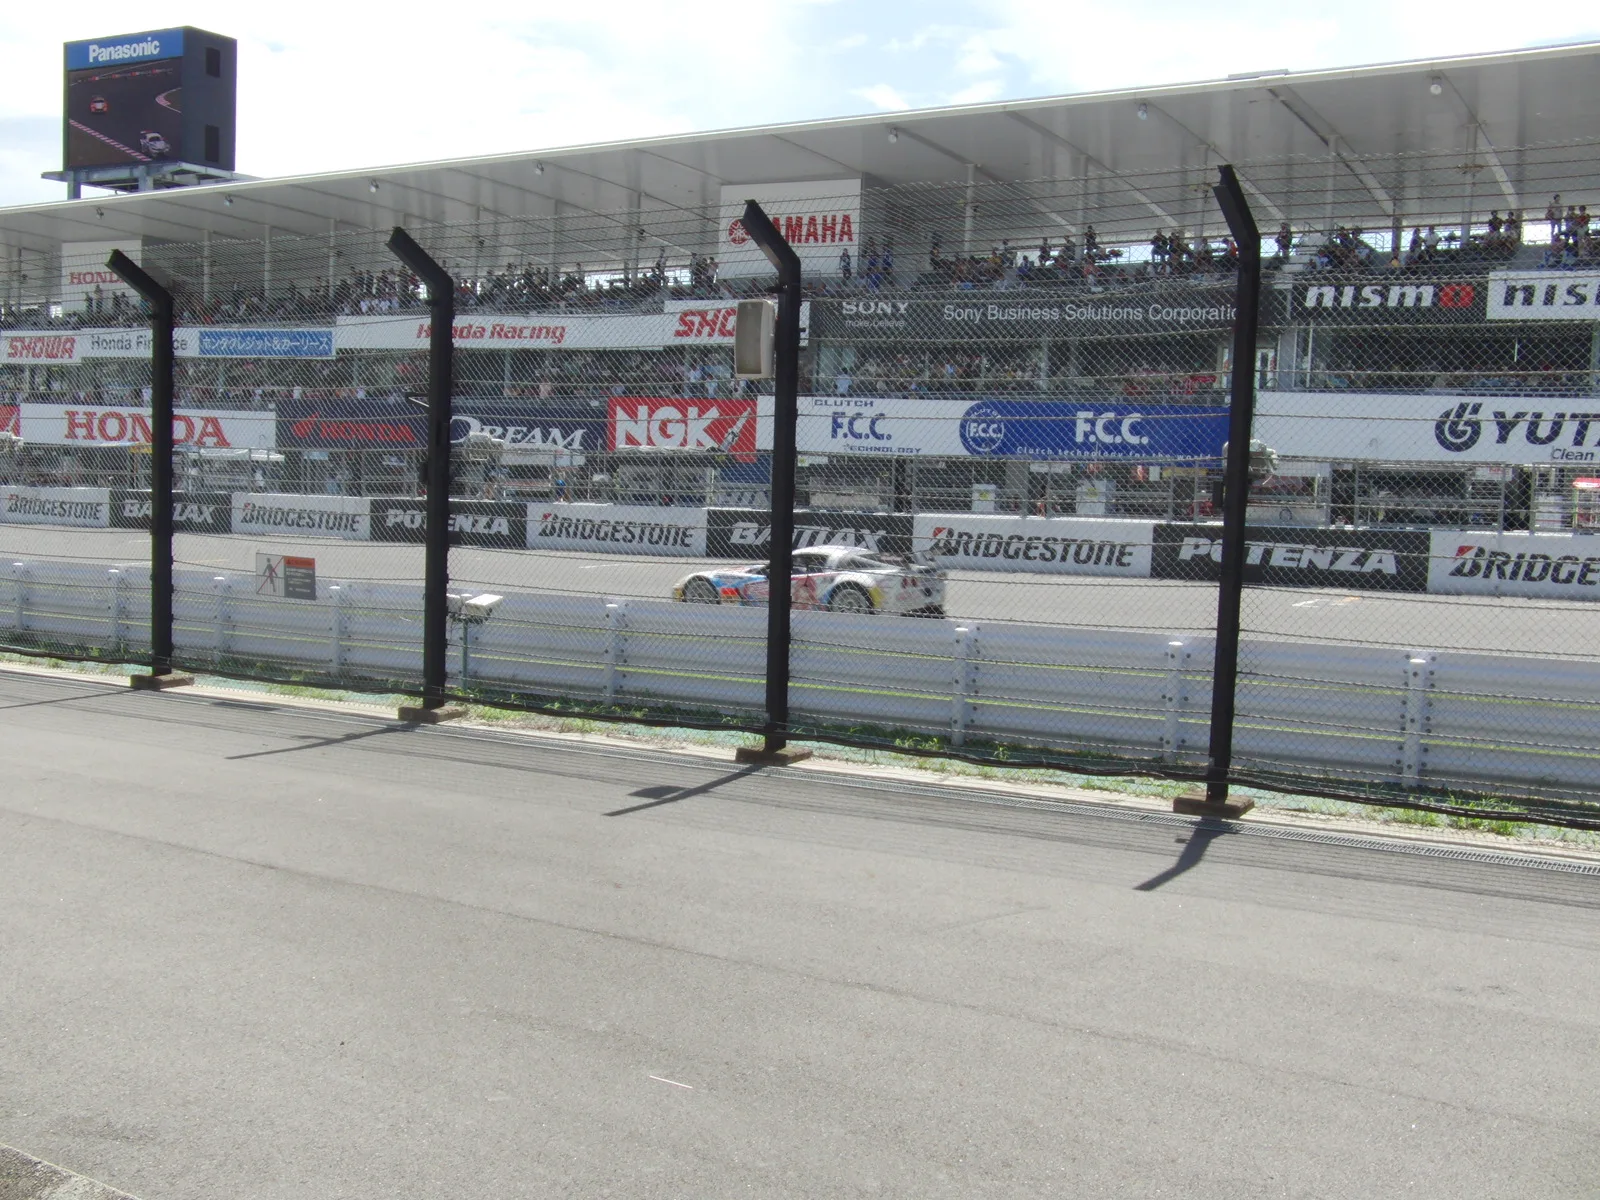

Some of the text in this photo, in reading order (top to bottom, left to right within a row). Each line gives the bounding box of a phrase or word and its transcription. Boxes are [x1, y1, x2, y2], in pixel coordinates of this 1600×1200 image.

[89, 37, 160, 63] Panasonic
[1304, 284, 1475, 308] nismo
[1503, 284, 1600, 306] nis
[842, 301, 908, 314] SONY
[944, 305, 981, 322] Sony
[987, 305, 1059, 320] Business
[1065, 304, 1143, 320] Solutions
[91, 333, 131, 350] Honda
[489, 324, 566, 344] Racing
[8, 337, 76, 358] SHOWA
[814, 399, 874, 407] CLUTCH
[320, 421, 416, 442] HONDA
[616, 405, 721, 449] NGK
[831, 411, 892, 440] F.C.C.
[1075, 411, 1149, 444] F.C.C.
[1493, 412, 1600, 447] YUT
[1551, 449, 1594, 461] Clean
[8, 494, 101, 520] BRIDGESTONE
[240, 503, 360, 532] BRIDGESTONE
[538, 513, 694, 547] BRIDGESTONE
[929, 527, 1134, 567] BRIDGESTONE
